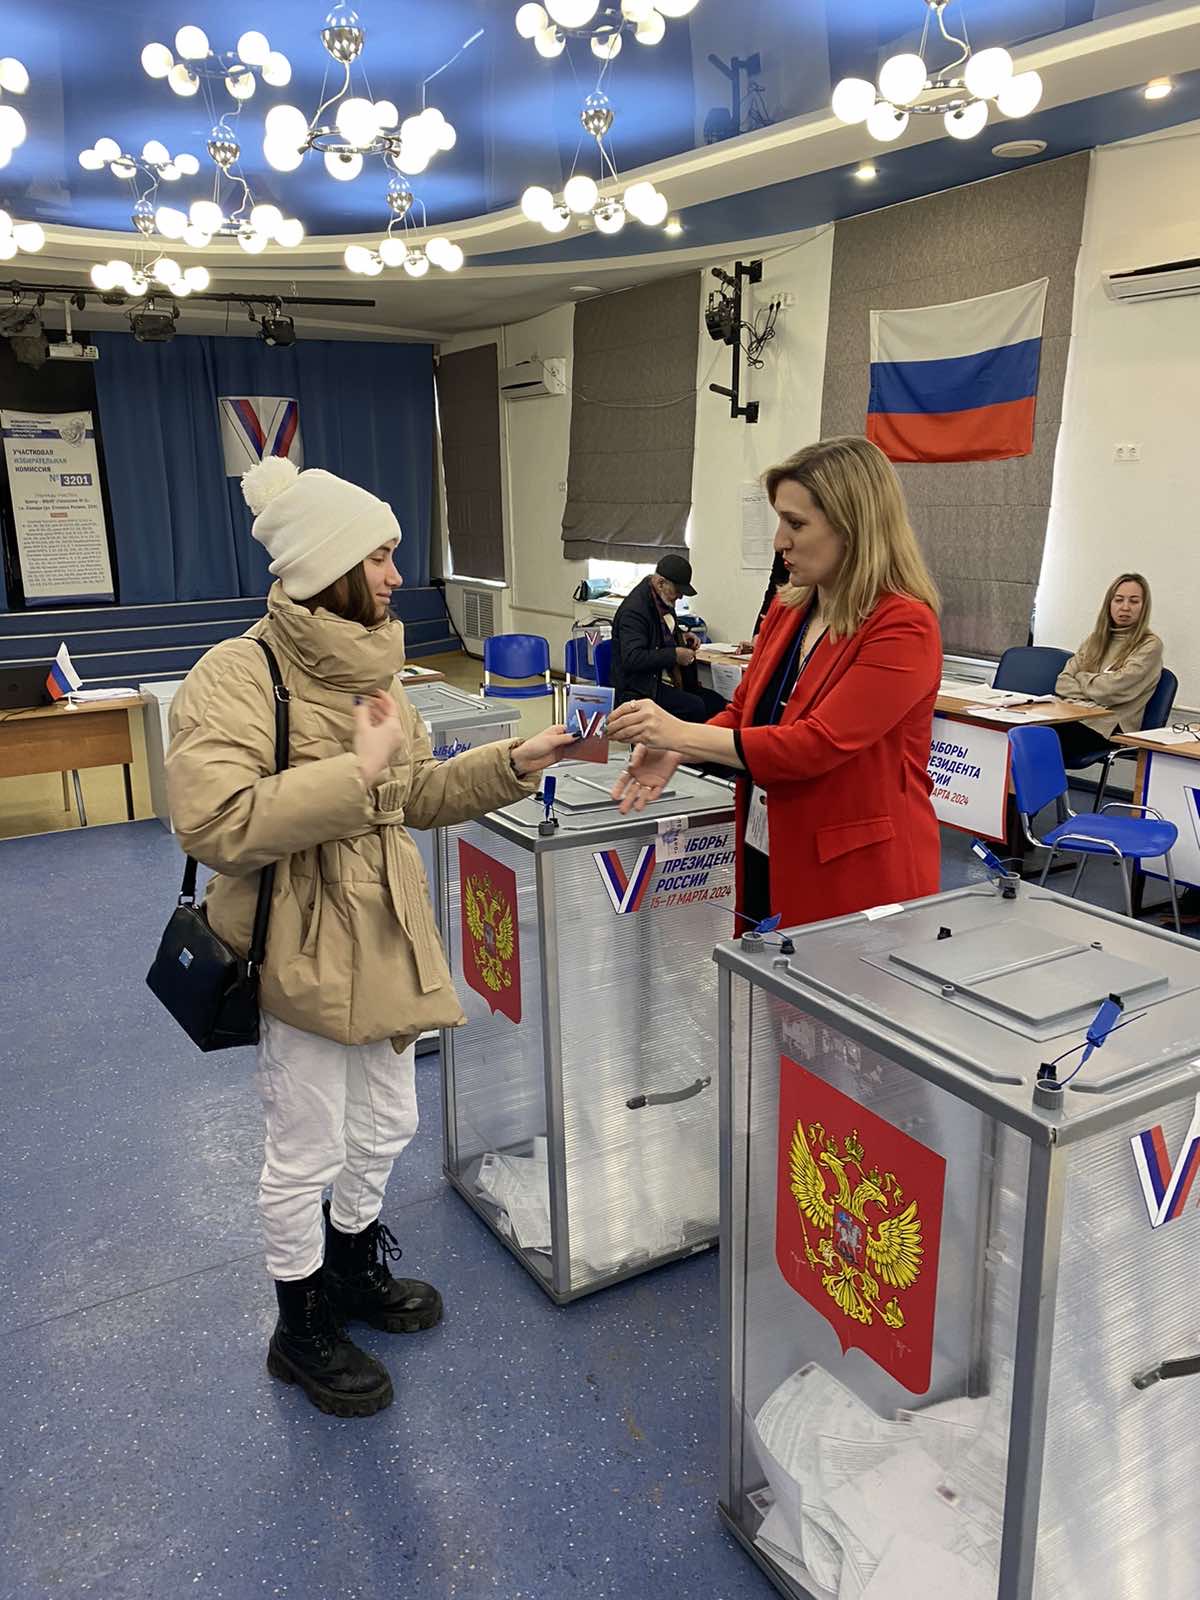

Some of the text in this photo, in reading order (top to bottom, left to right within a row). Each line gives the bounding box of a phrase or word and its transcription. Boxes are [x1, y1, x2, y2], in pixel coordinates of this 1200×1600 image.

[12, 448, 54, 456] УЧАСТКОВАЯ
[63, 475, 89, 485] 3201
[930, 740, 968, 759] ЫБОРЫ
[928, 755, 981, 779] ЕЗИДЕНТА
[931, 787, 969, 806] АРТА 2024
[685, 834, 728, 852] БОРЫ
[662, 851, 736, 874] ПРЕЗИДЕНТ
[656, 872, 709, 893] РОССИИ
[676, 890, 708, 905] МАРТА
[710, 885, 732, 900] 2024
